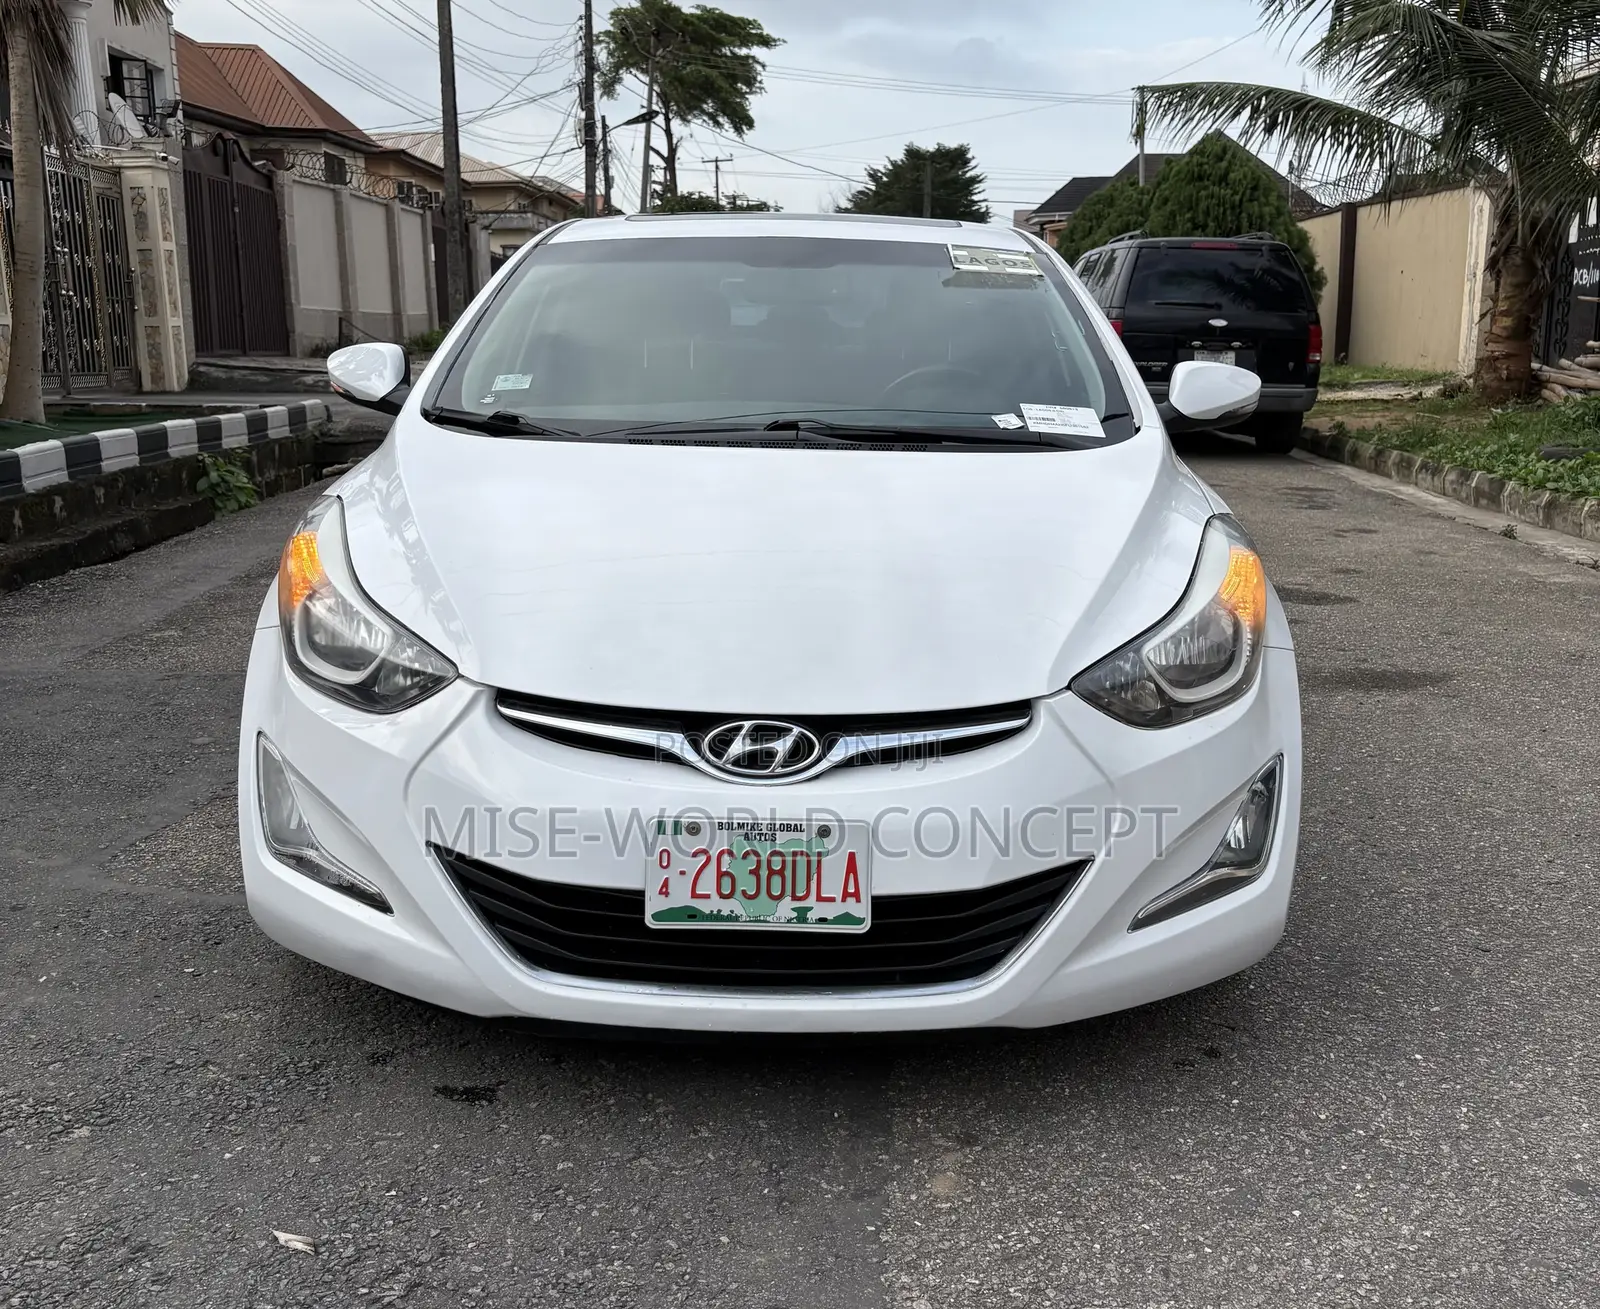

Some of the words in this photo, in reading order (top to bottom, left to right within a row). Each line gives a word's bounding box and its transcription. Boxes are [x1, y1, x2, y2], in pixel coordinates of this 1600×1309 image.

[953, 256, 1033, 268] LAGOS
[717, 821, 763, 832] BOLMIKE
[766, 823, 805, 833] GLOBAL
[743, 832, 777, 842] AUTOS
